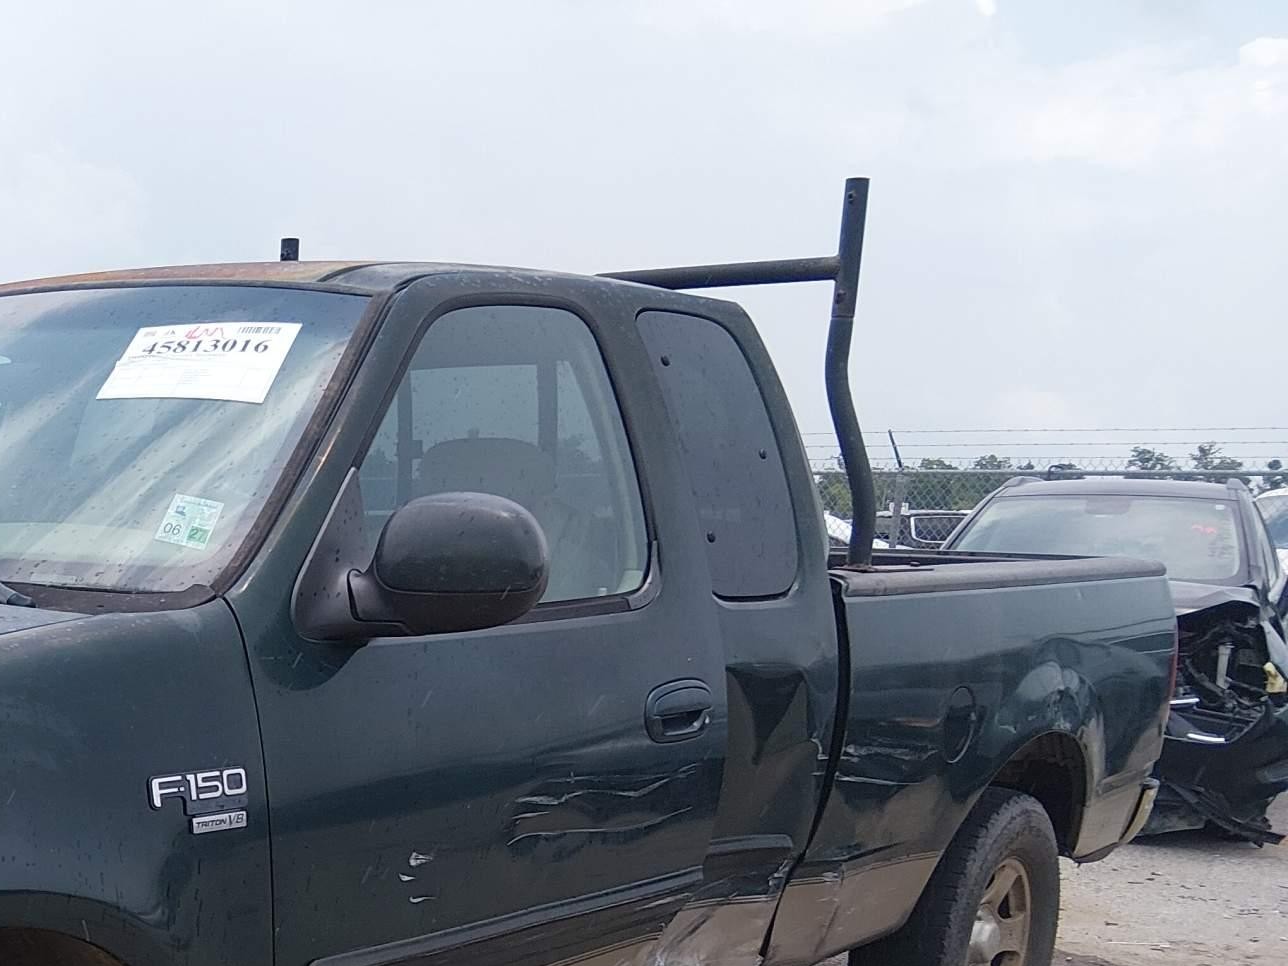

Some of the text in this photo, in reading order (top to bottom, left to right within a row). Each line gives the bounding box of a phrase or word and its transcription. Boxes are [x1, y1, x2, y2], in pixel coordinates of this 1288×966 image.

[141, 338, 271, 355] 45813016
[163, 522, 182, 536] 06
[195, 813, 245, 829] TRITON V8
